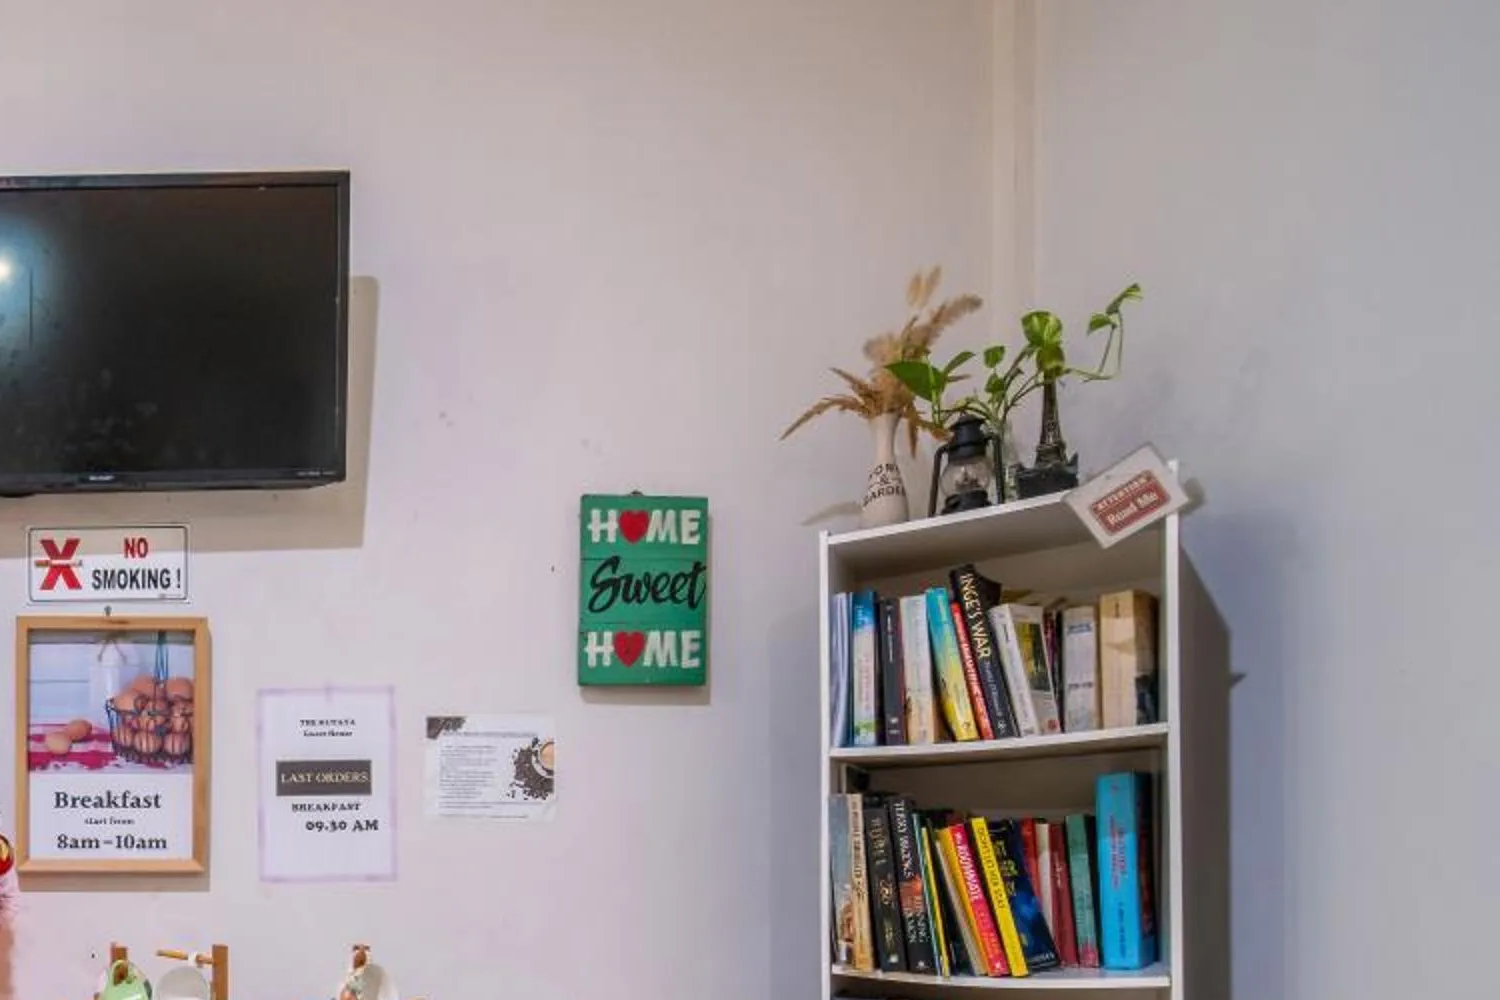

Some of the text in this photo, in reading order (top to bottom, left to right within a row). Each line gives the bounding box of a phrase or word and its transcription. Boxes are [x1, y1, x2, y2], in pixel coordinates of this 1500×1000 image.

[124, 537, 149, 558] NO
[92, 568, 171, 590] SMOKING
[588, 555, 707, 613] Sweet
[960, 573, 983, 620] INGE'S
[969, 621, 991, 658] WAR
[281, 772, 369, 783] LAST ORDERS
[54, 790, 161, 809] Breakfast
[291, 803, 361, 812] BREAKFAST
[305, 820, 379, 832] 09.30 AM
[958, 844, 982, 901] ROOMMATE
